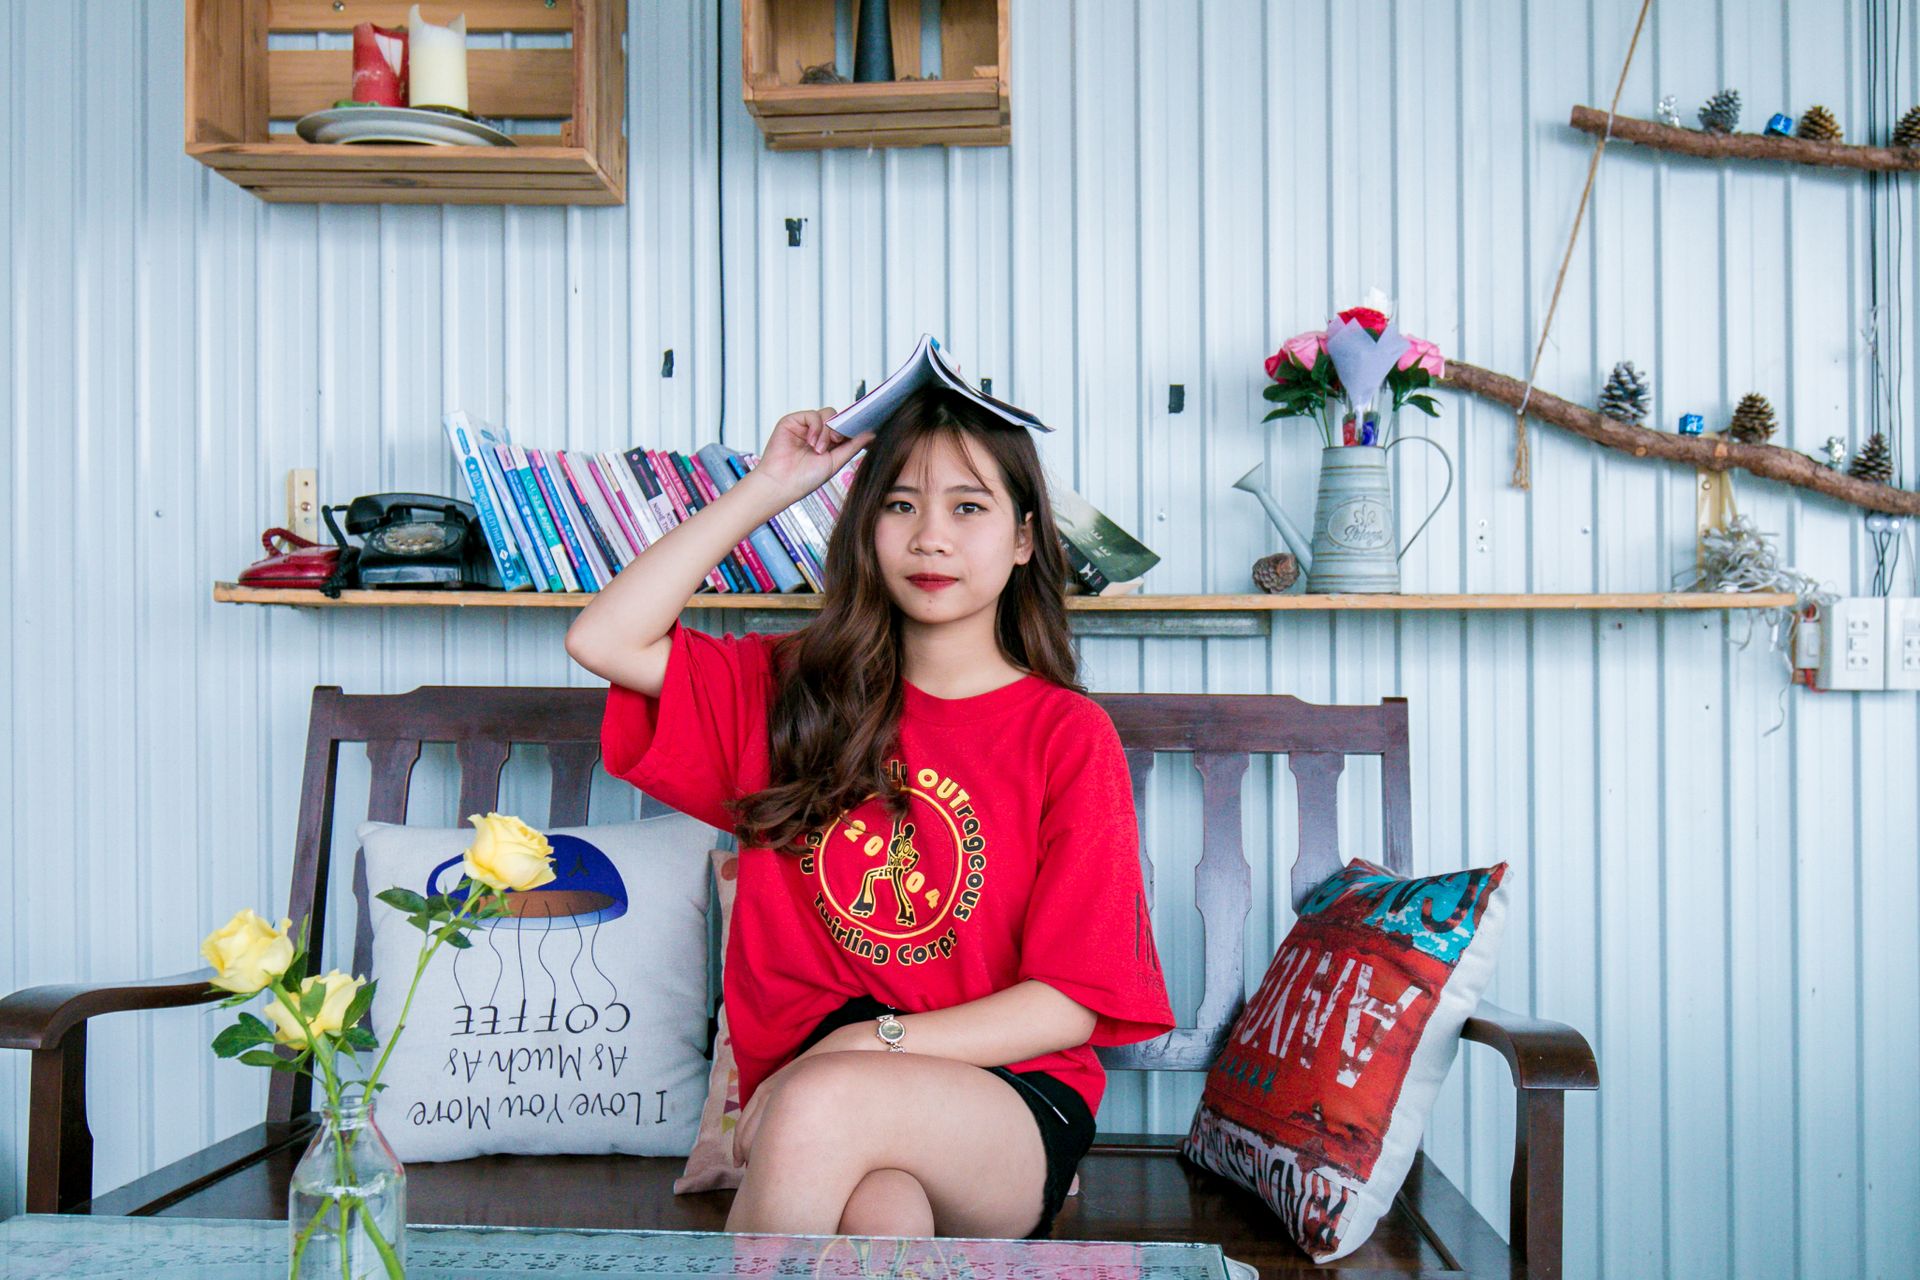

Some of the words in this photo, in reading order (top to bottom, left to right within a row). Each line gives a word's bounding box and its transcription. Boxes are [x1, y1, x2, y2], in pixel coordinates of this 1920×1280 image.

[813, 892, 891, 966] Twirling
[896, 927, 958, 966] Corps
[450, 1000, 631, 1037] COFFEE
[489, 1044, 582, 1085] Much
[407, 1095, 492, 1130] More
[498, 1093, 565, 1126] You
[575, 1091, 642, 1126] Love
[654, 1090, 668, 1125] I
